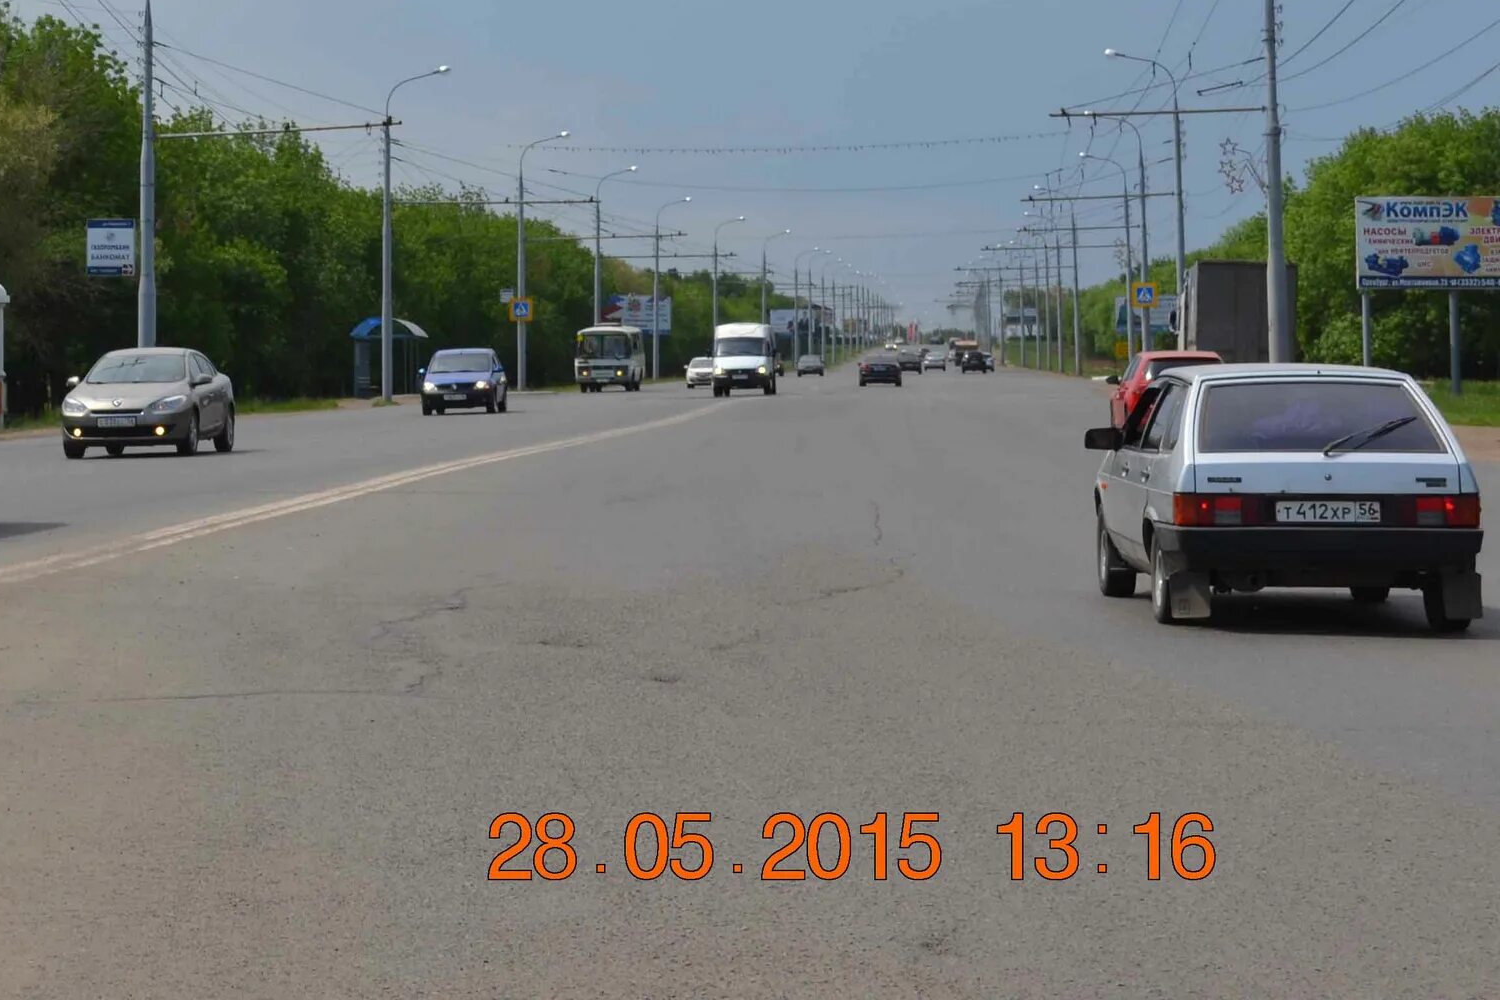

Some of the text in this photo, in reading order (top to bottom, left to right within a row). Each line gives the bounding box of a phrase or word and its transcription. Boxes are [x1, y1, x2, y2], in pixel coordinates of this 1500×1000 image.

[1363, 226, 1407, 236] НАСОСЫ
[1284, 502, 1377, 519] Т412ХР 56
